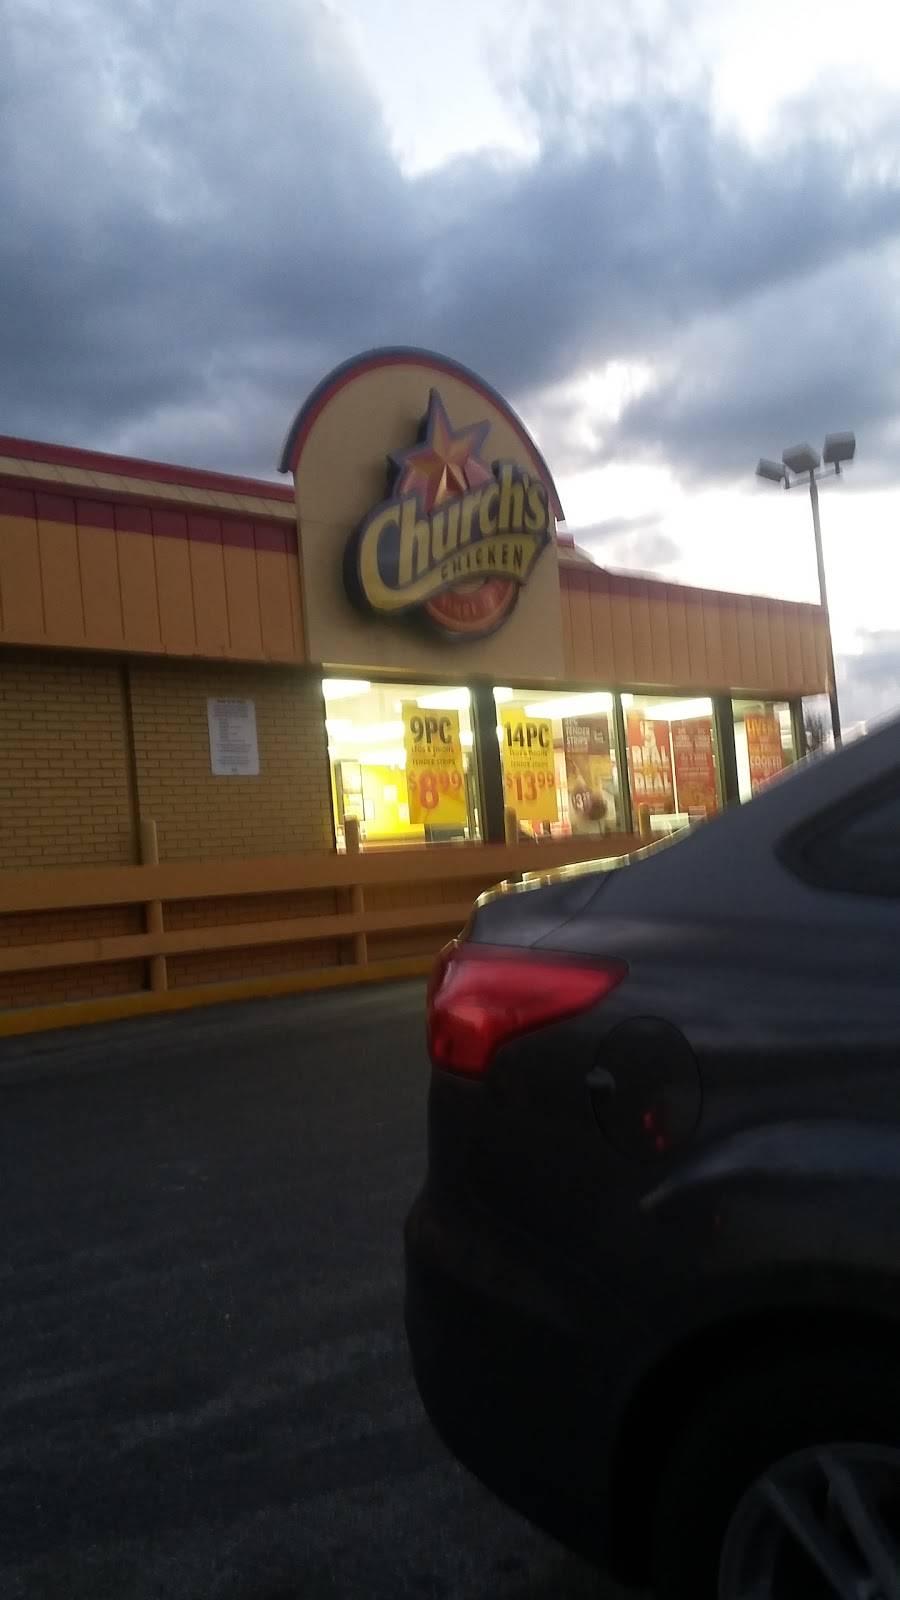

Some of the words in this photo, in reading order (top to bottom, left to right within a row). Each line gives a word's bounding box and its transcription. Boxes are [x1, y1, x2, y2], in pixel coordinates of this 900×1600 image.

[360, 464, 546, 610] Church's
[441, 543, 524, 581] CHICKEN
[410, 716, 453, 744] 9PC
[504, 721, 550, 748] 14PC
